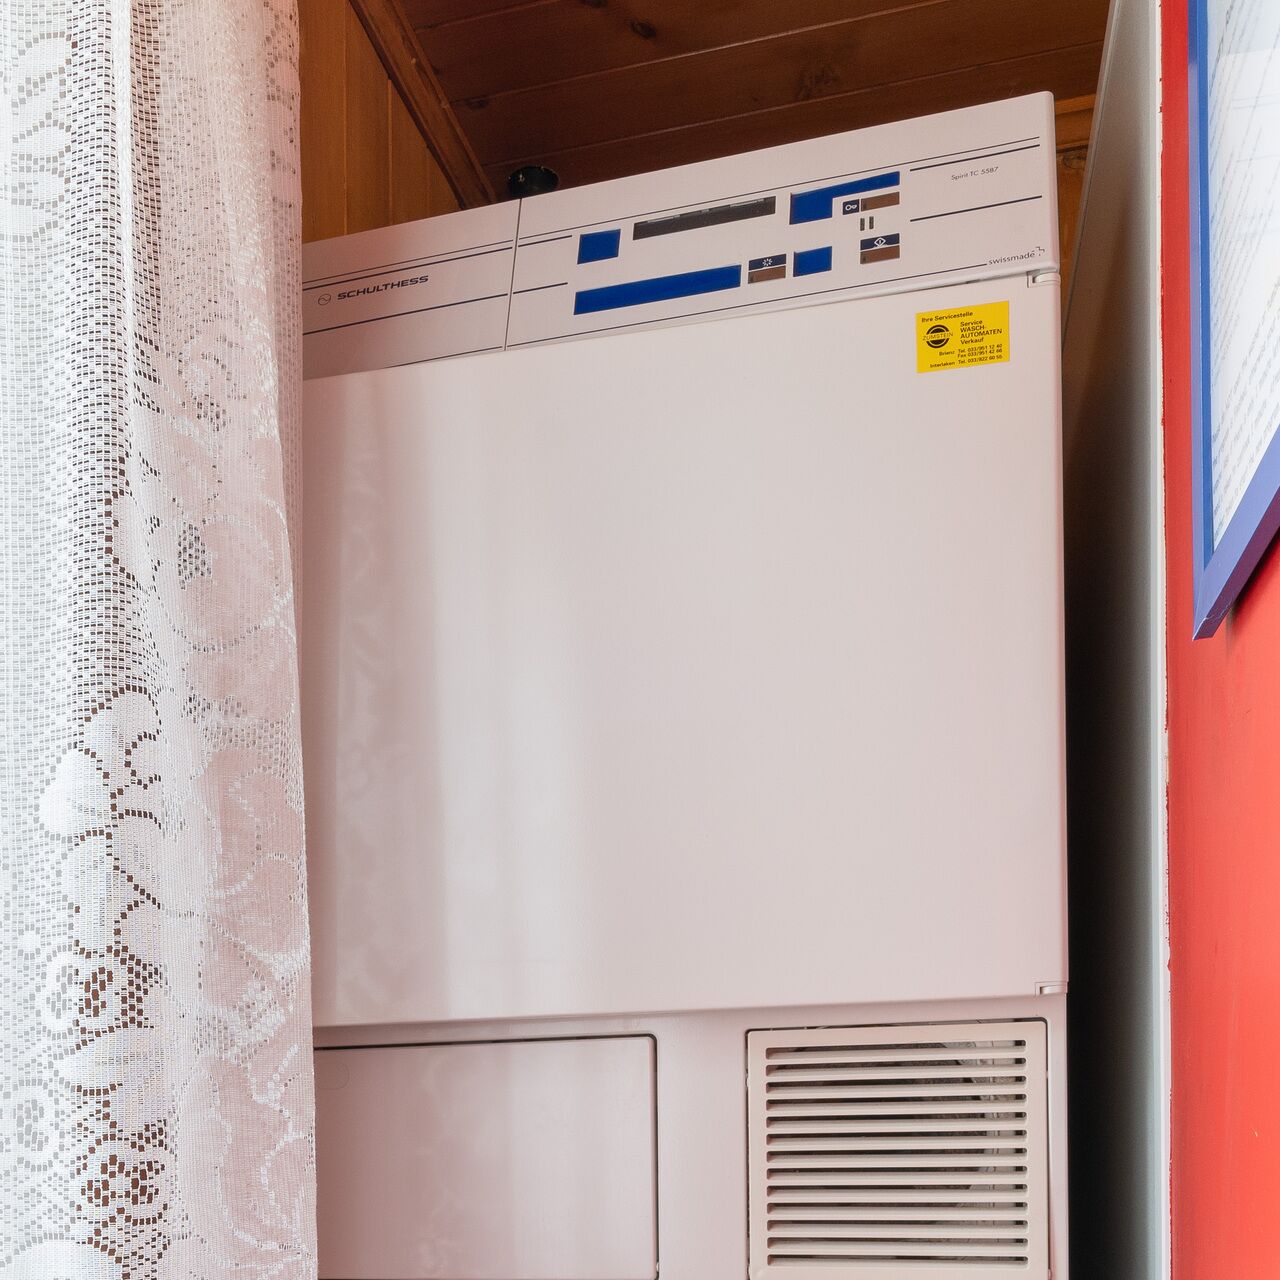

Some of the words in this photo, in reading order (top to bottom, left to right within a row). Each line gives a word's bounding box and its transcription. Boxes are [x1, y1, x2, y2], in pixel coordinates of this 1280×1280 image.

[951, 172, 969, 181] Spirit
[980, 166, 1000, 176] 5587
[337, 275, 429, 300] SCHULTHESS
[934, 311, 973, 321] Servicestelle
[960, 319, 983, 327] Service
[923, 332, 953, 341] ZUMSTEIN
[960, 328, 1002, 339] AUTOMATEN
[960, 337, 984, 345] Verkauf
